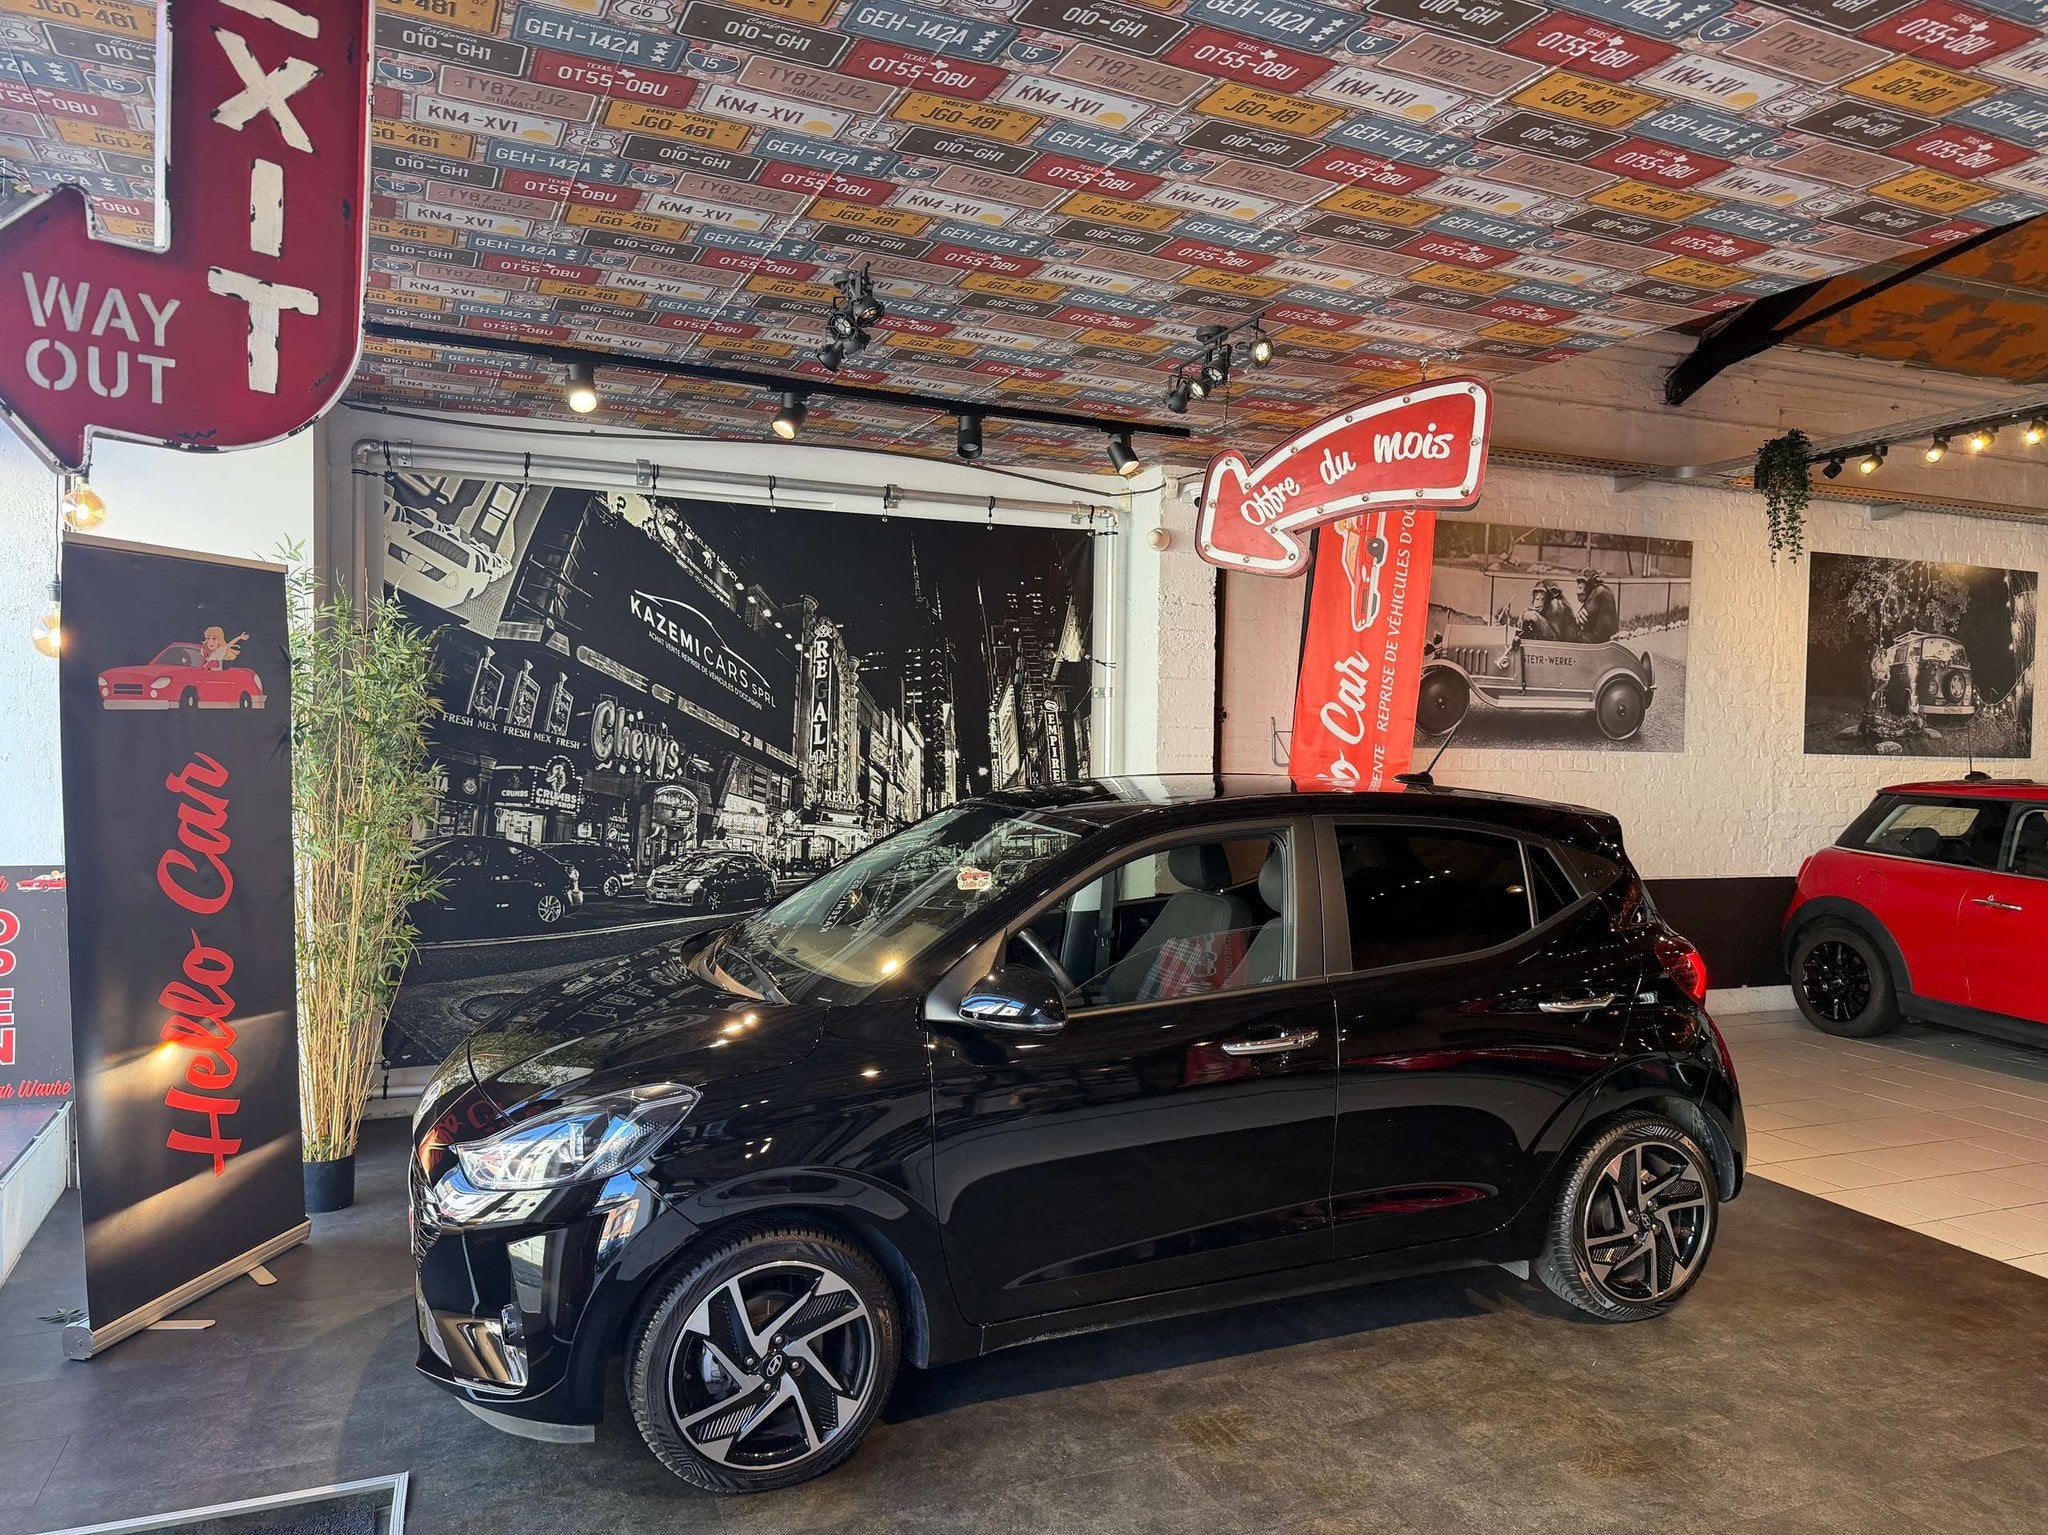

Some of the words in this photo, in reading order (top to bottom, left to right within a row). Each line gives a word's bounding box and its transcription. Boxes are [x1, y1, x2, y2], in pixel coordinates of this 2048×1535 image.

[523, 17, 644, 56] GEH-142A
[853, 6, 973, 46] GEH-142A
[1353, 36, 1382, 50] 15
[1705, 23, 1739, 38] 15
[585, 62, 612, 72] TEXAS
[699, 57, 720, 70] 15
[900, 53, 928, 63] TEXAS
[1018, 46, 1043, 60] 15
[1230, 42, 1259, 53] TEXAS
[103, 78, 124, 91] 15
[208, 0, 322, 394] XIT
[22, 270, 181, 348] WAY
[25, 338, 177, 405] OUT
[1240, 474, 1301, 526] Offre
[1319, 449, 1357, 485] du
[1373, 422, 1454, 464] mois
[1387, 548, 1411, 635] VÉHICULES
[1383, 640, 1399, 663] DE
[751, 682, 777, 708] SPRL
[812, 640, 830, 746] REGAL
[1319, 651, 1371, 745] Car
[1376, 664, 1396, 733] REPRISE
[442, 712, 474, 727] FRESH
[477, 719, 498, 732] MEX
[503, 725, 531, 739] FRESH
[533, 732, 551, 744] MEX
[556, 737, 581, 750] FRESH
[591, 699, 680, 780] Chevys
[1047, 713, 1061, 781] EMPIRE
[501, 789, 529, 798] CRUMBS
[536, 787, 577, 804] CRUMBS
[156, 751, 236, 916] Car
[158, 928, 242, 1178] Hello
